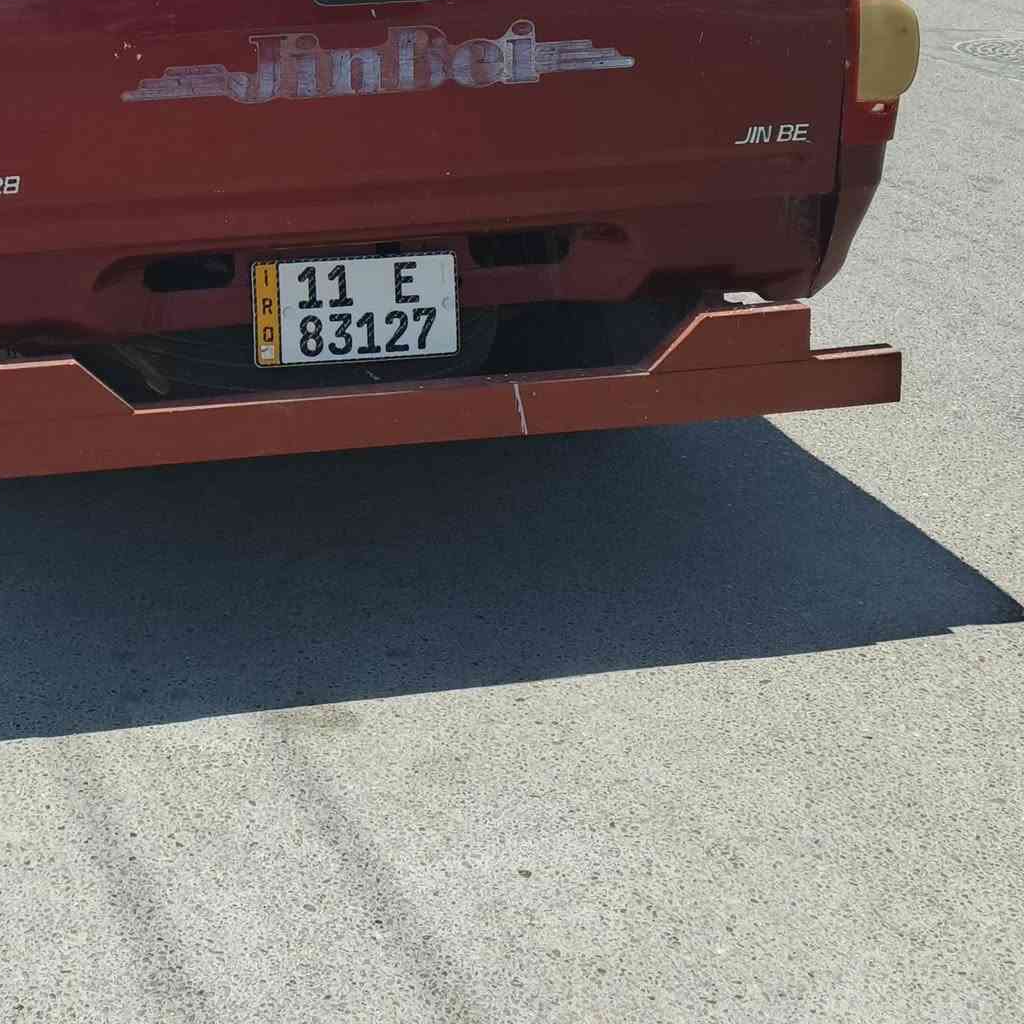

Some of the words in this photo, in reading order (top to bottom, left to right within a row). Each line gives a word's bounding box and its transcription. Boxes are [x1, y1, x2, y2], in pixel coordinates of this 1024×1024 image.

[734, 124, 772, 145] JIN
[297, 263, 354, 310] 11
[394, 261, 420, 304] E
[299, 307, 438, 357] 83127
